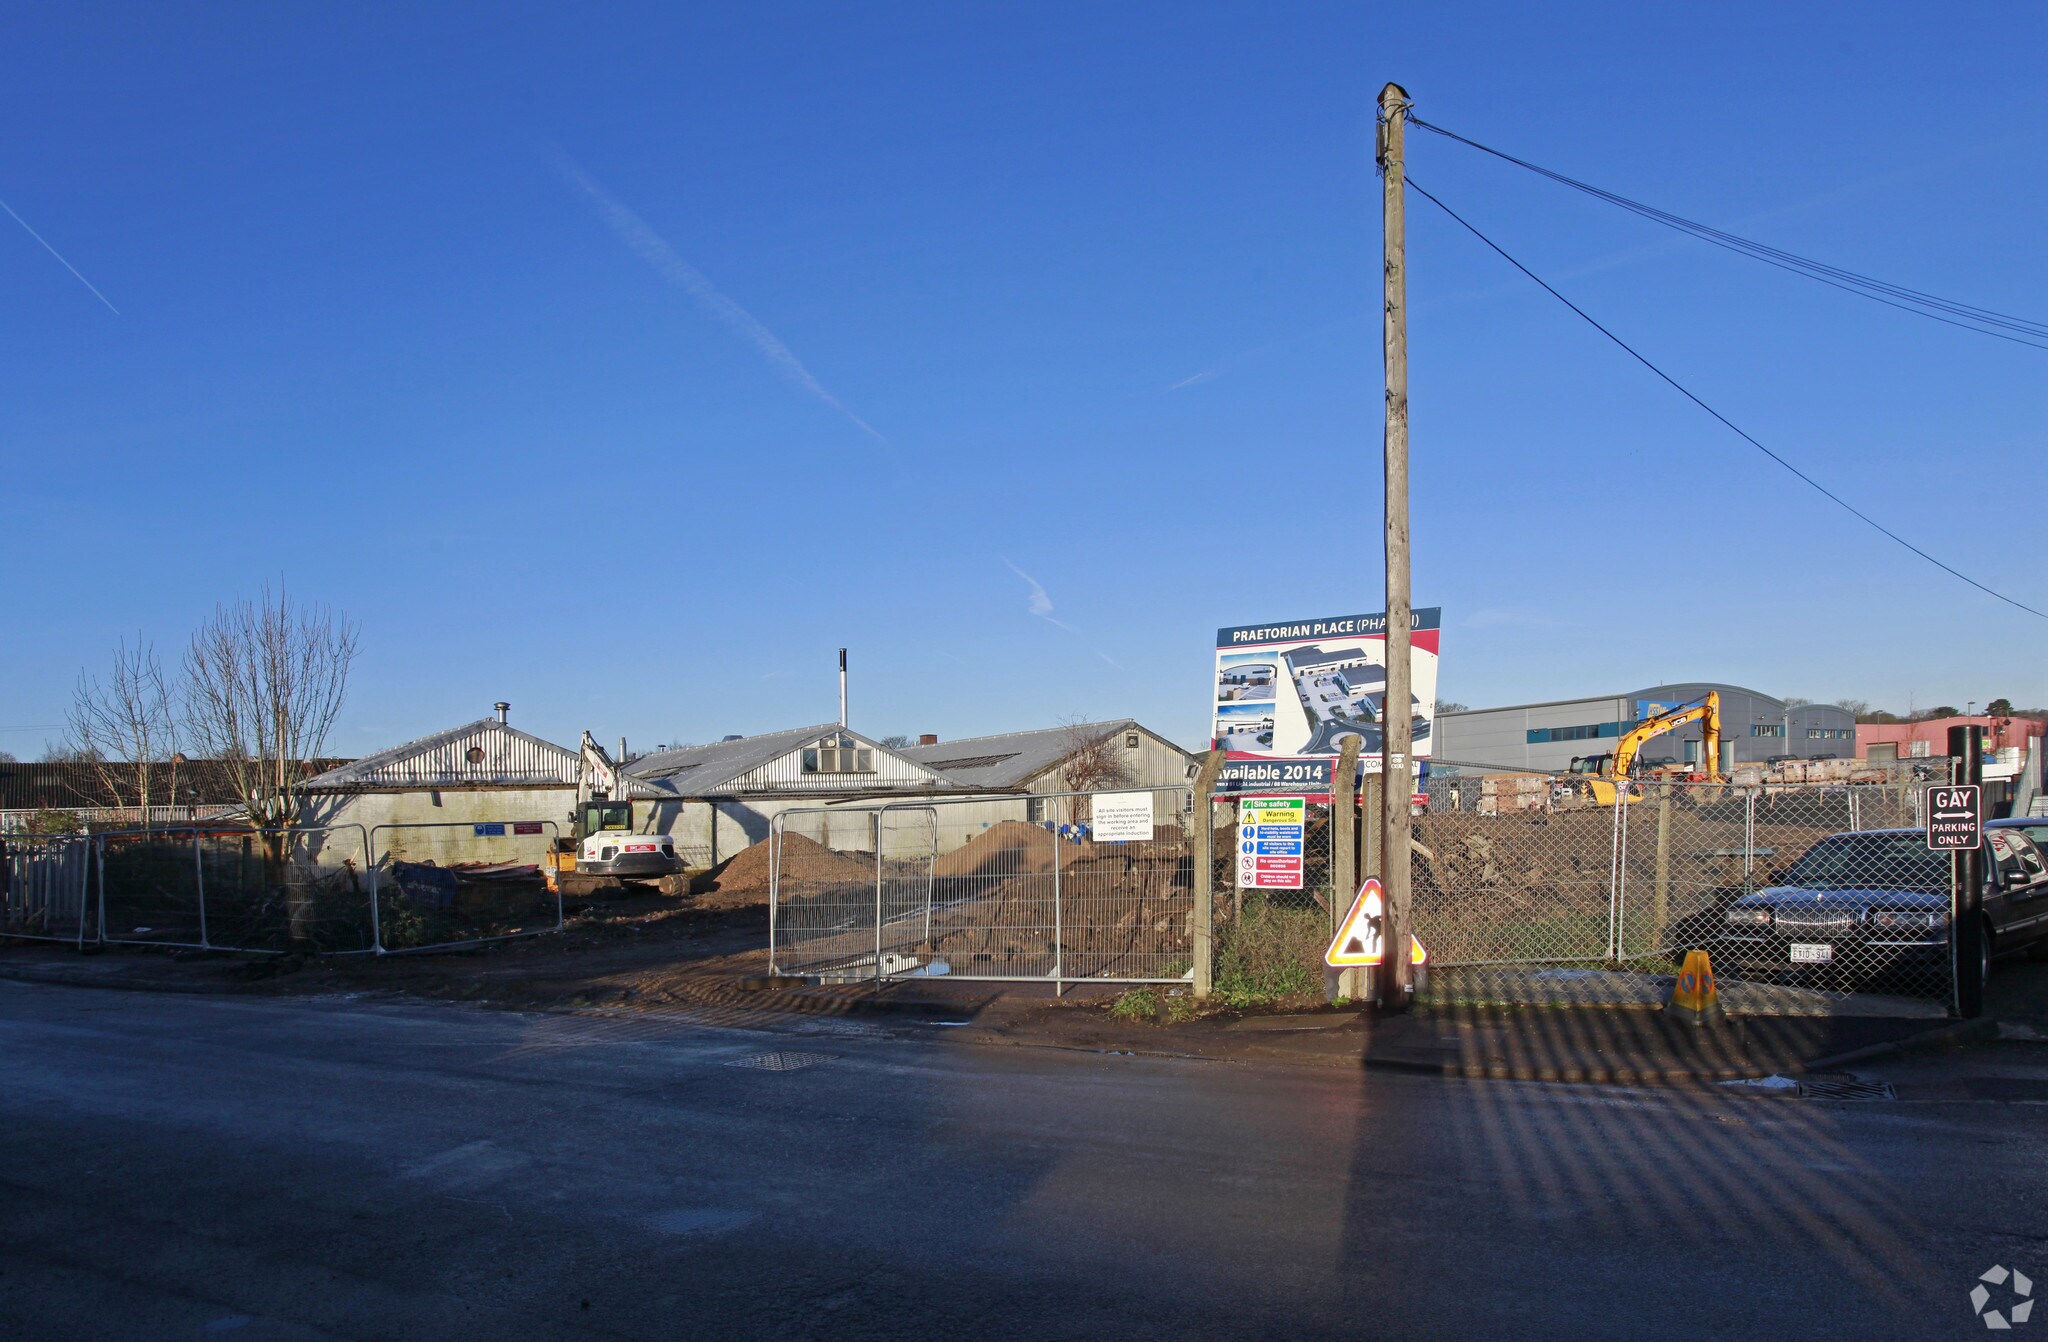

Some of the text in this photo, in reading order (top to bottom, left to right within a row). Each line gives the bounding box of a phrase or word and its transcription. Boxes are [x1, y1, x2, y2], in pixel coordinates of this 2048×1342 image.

[1233, 624, 1310, 642] PRAETORIAN
[1314, 621, 1354, 635] PLACE
[1672, 716, 1687, 727] JCB
[1219, 765, 1323, 780] vailable 2014
[1936, 791, 1971, 808] GAY
[1932, 823, 1976, 832] PARKING
[1938, 835, 1969, 844] ONLY
